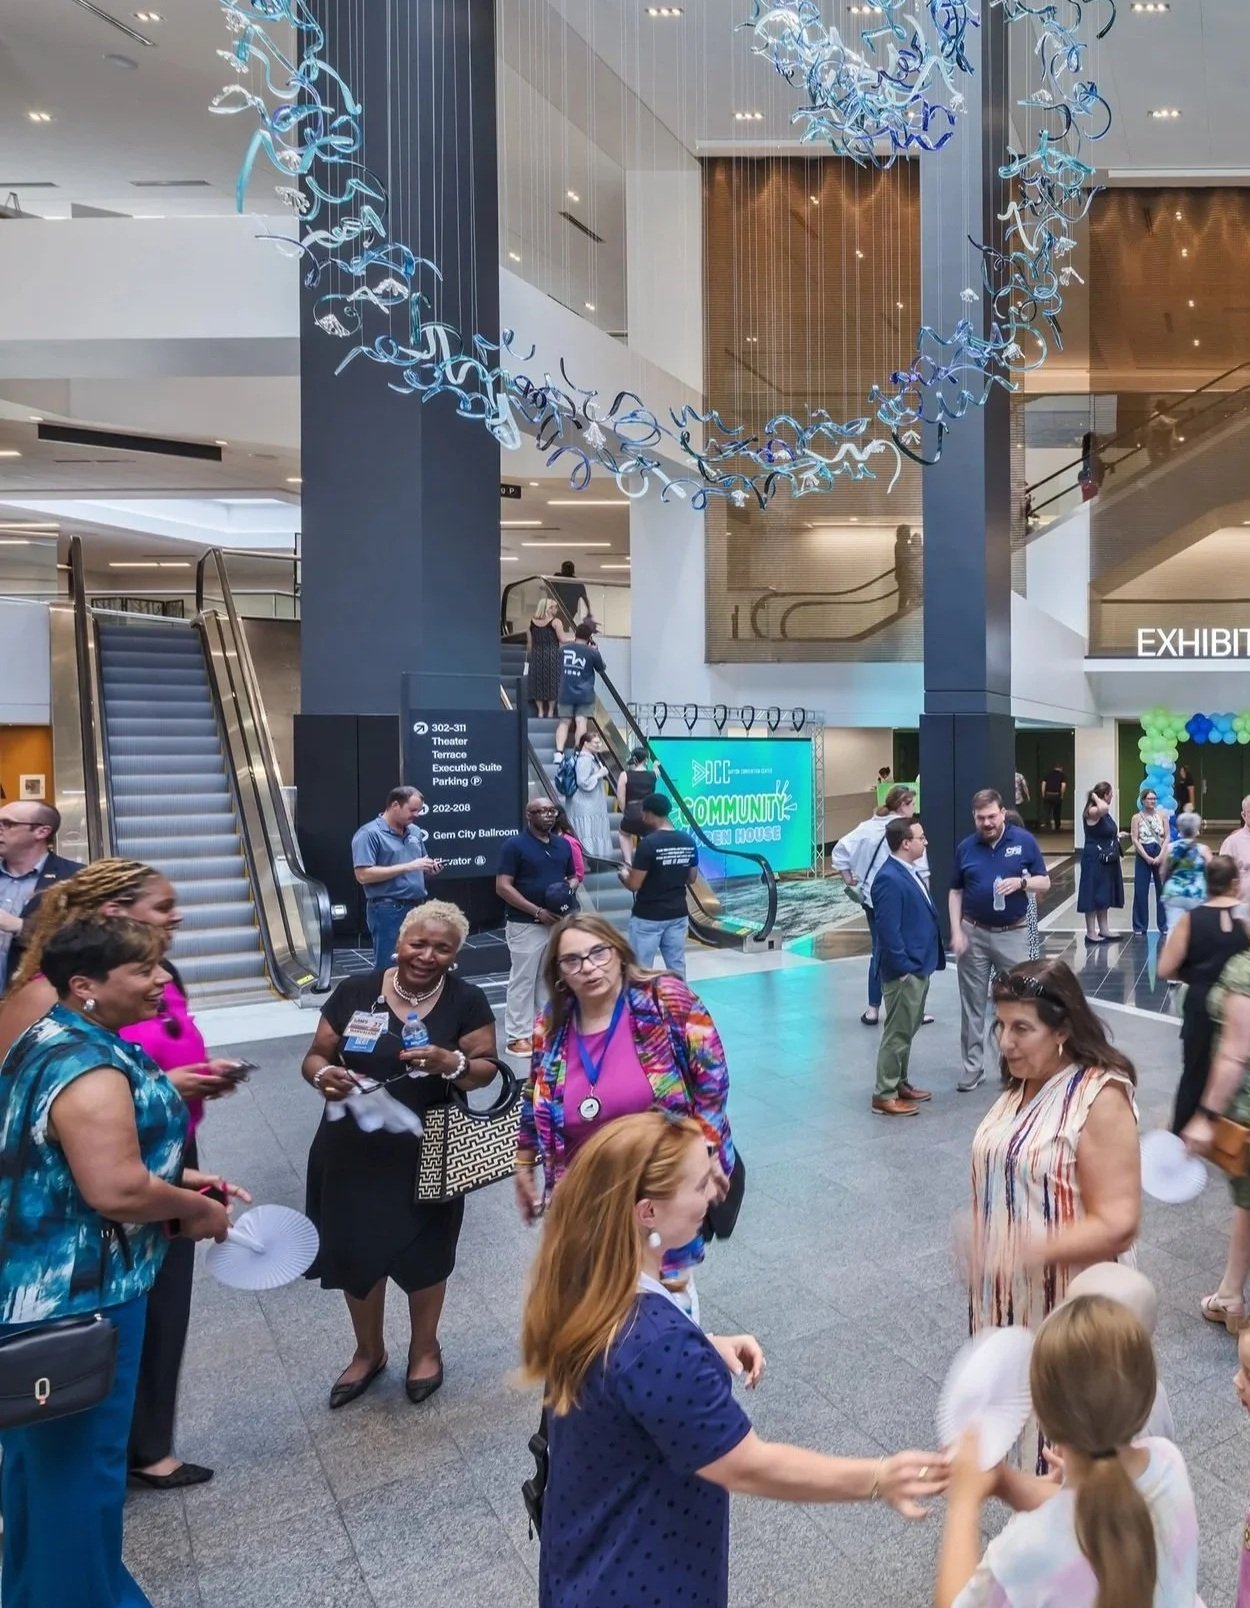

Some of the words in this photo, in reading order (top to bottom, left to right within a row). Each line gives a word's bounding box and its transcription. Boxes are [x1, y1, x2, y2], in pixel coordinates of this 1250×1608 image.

[431, 723, 467, 733] 302-311
[432, 736, 468, 746] Theater
[432, 750, 467, 760] Terrace
[432, 763, 477, 773] Executive
[478, 762, 502, 772] Suite
[432, 777, 469, 788] Parking
[432, 803, 471, 813] 202-208
[679, 793, 787, 828] COMMUNITY
[433, 830, 456, 840] Gem
[457, 828, 477, 840] City
[478, 828, 519, 838] Ballroom
[735, 825, 782, 845] HOUSE
